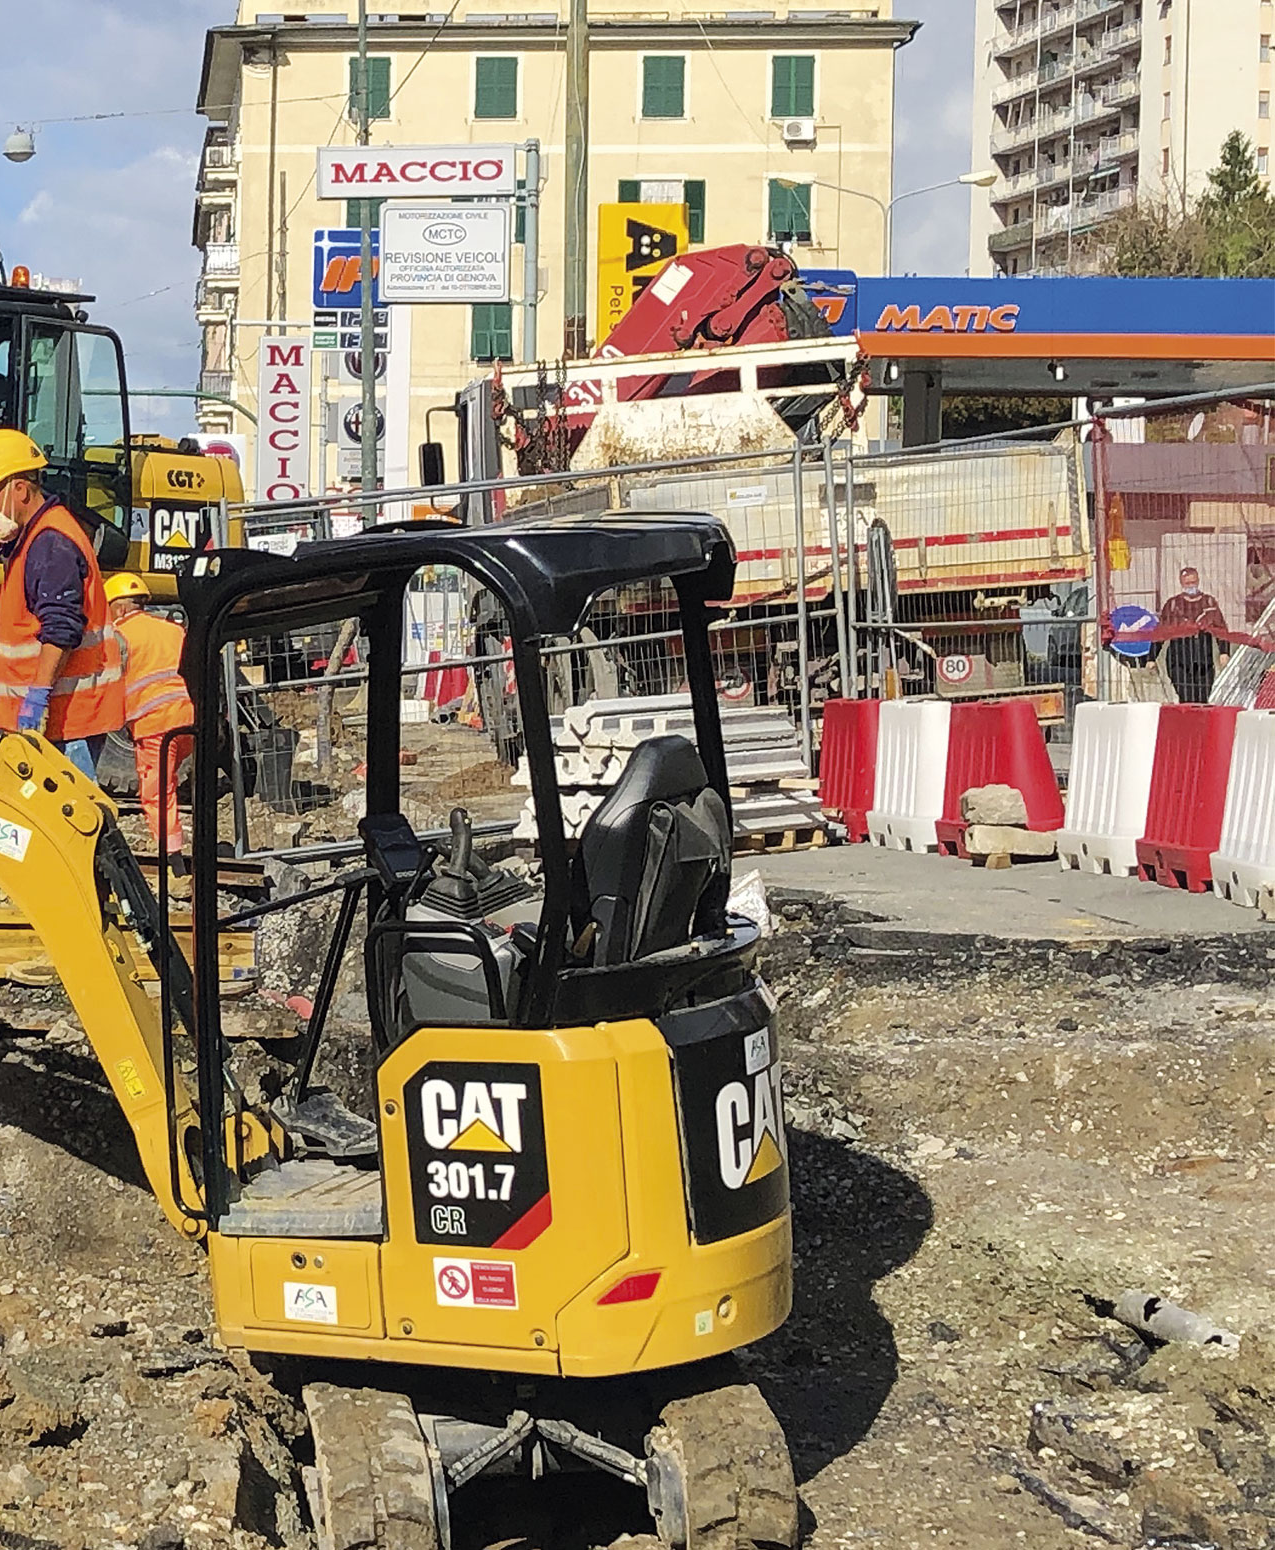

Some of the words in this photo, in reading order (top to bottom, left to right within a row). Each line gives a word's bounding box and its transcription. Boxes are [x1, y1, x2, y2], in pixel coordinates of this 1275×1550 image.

[465, 212, 488, 220] CIVILE
[428, 228, 463, 240] MCTC
[385, 252, 452, 263] REVISIONE
[390, 274, 442, 282] PROVINCIA
[445, 274, 454, 282] DI
[456, 274, 496, 282] GENOVA
[609, 285, 624, 317] Pet
[875, 304, 1020, 332] MATIC
[154, 508, 200, 549] CAT
[945, 659, 965, 673] 80
[420, 1079, 527, 1153] CAT
[427, 1161, 515, 1200] 301.7
[431, 1204, 467, 1235] CR
[294, 1287, 327, 1308] ASA
